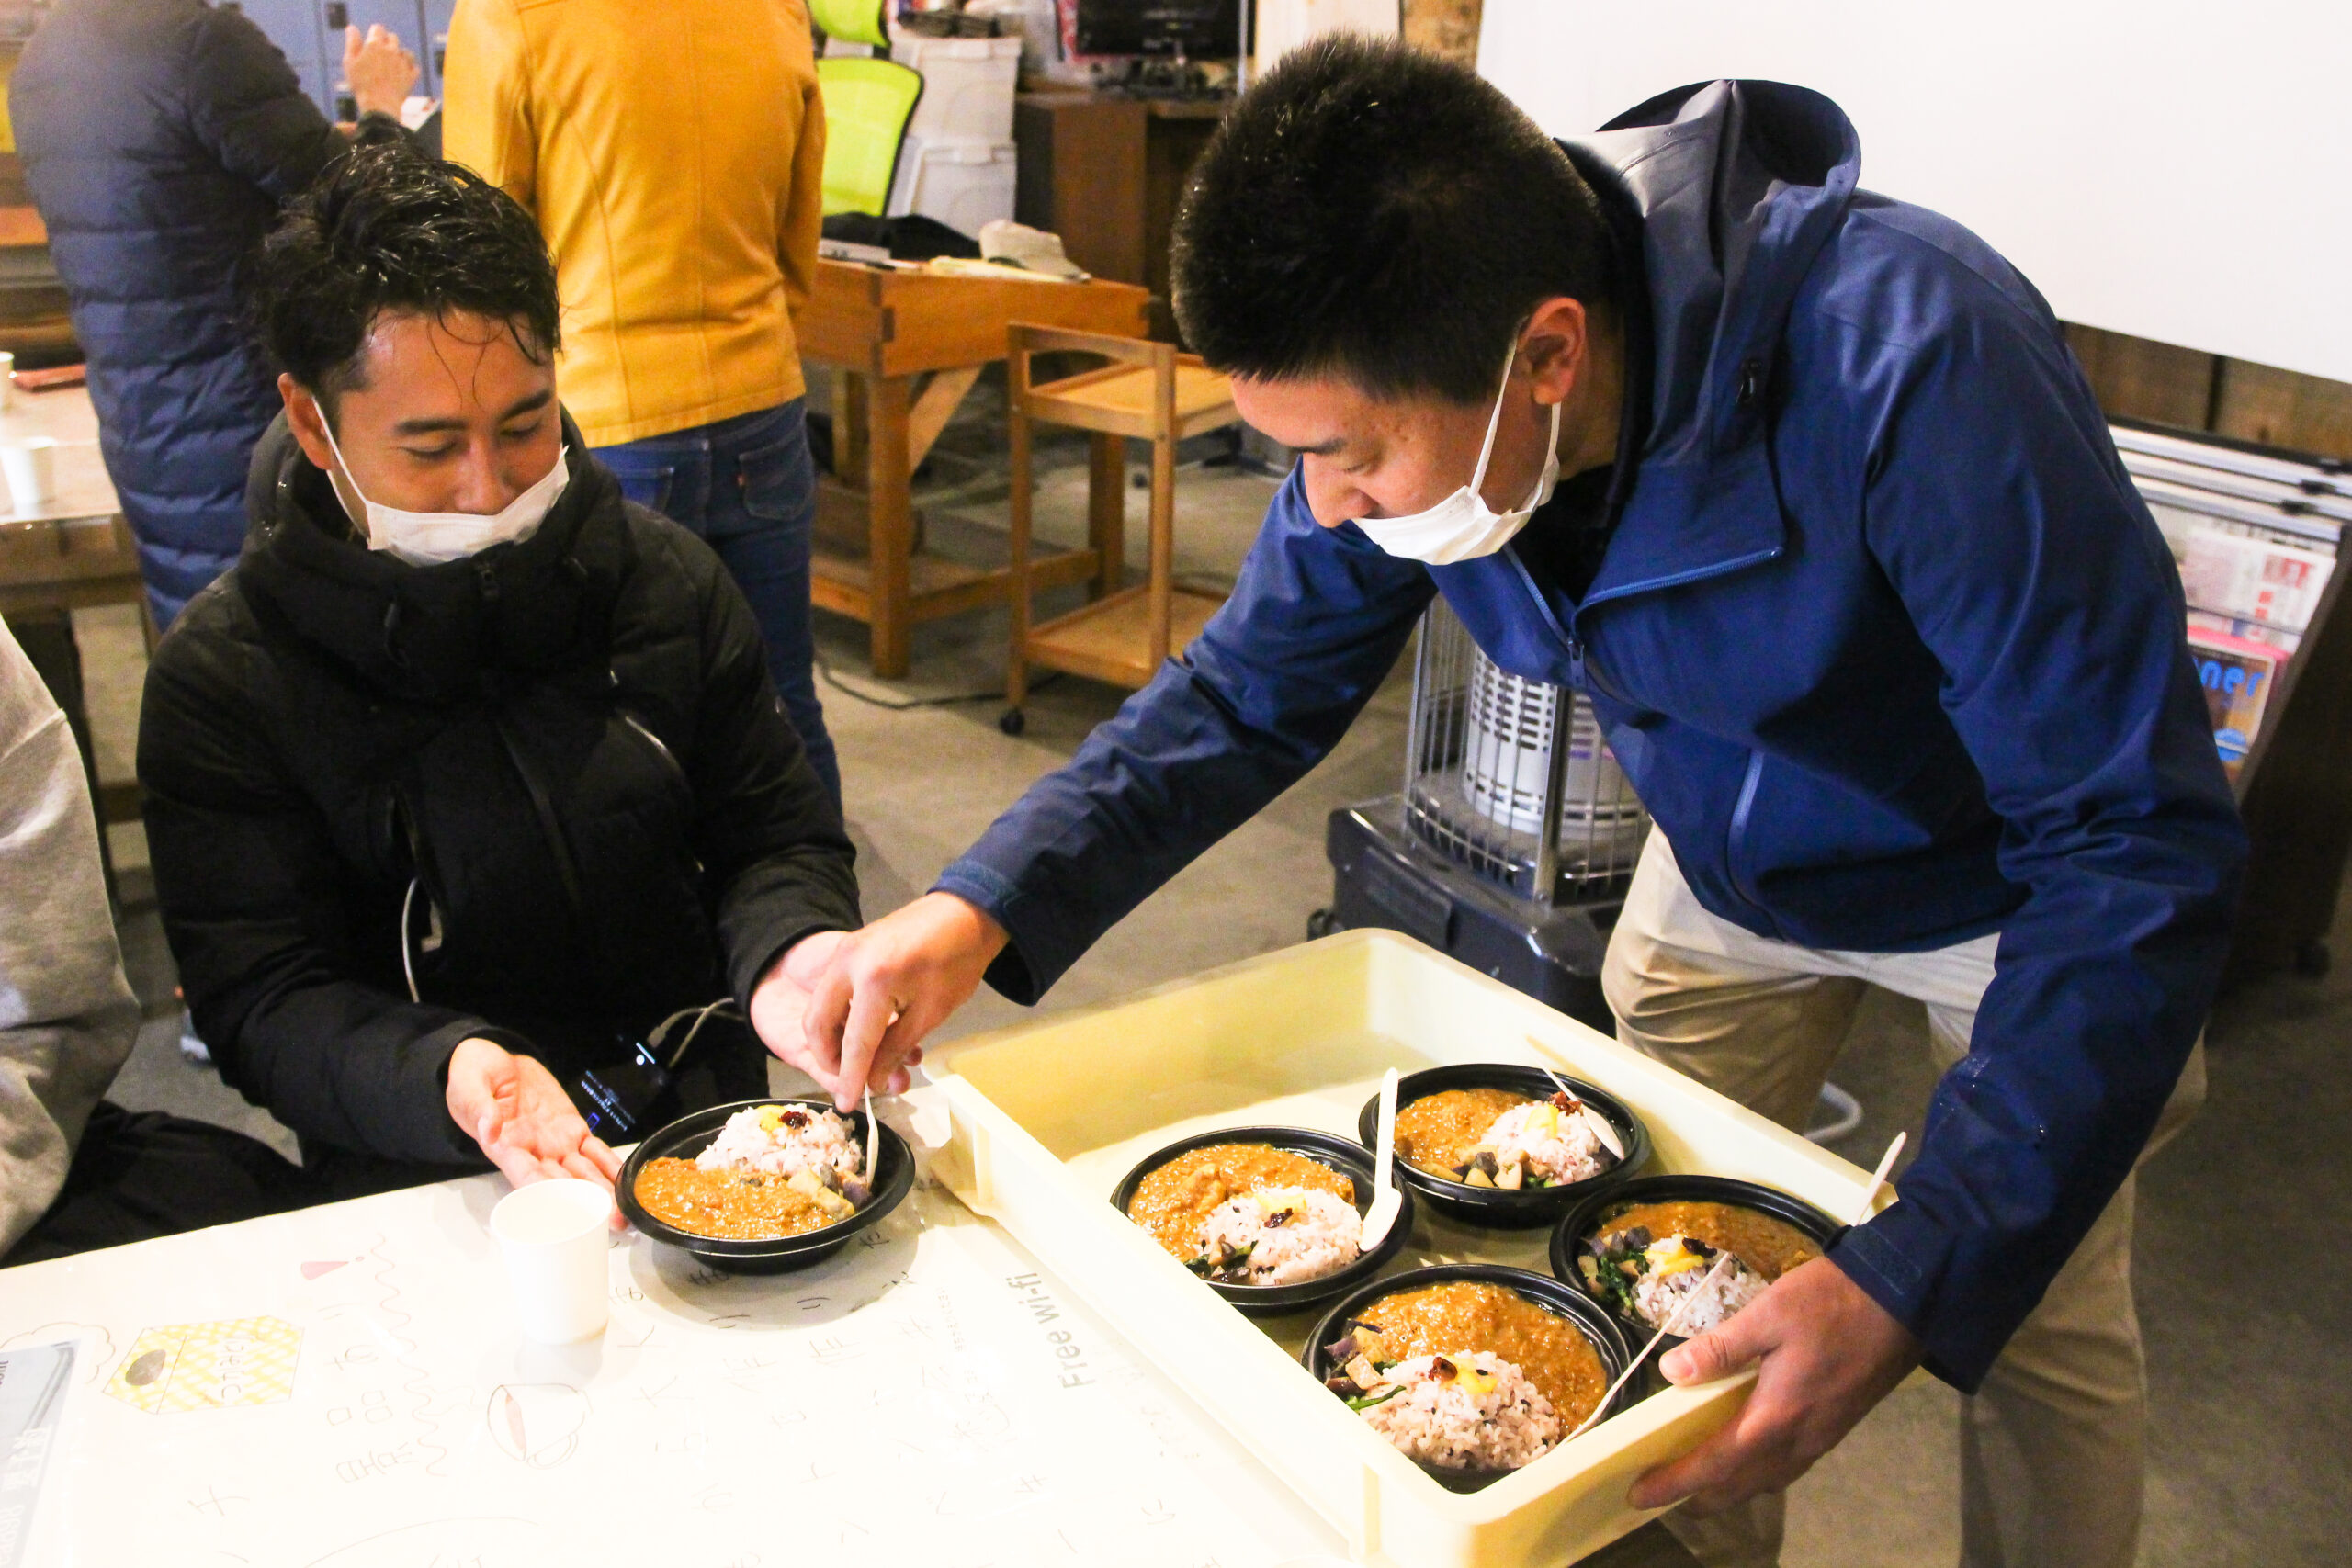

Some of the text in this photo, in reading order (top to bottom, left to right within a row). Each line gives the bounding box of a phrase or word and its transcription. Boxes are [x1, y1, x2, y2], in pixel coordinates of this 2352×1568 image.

[2192, 656, 2265, 696] ner
[1005, 1272, 1096, 1389] Free wi-fi
